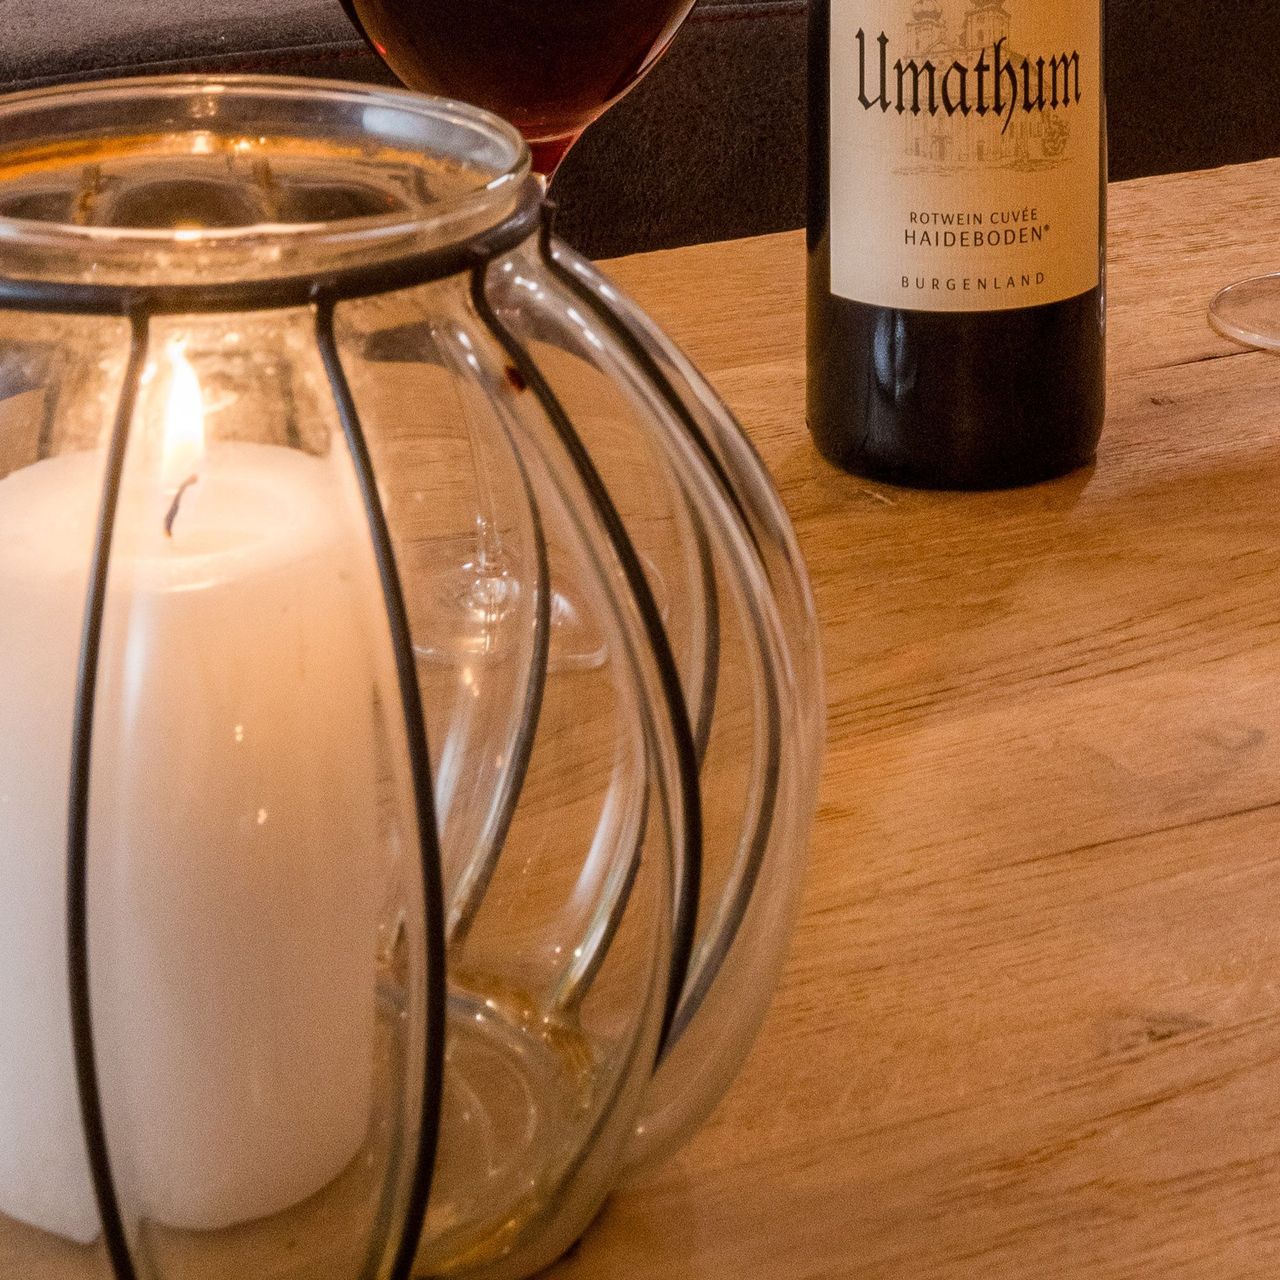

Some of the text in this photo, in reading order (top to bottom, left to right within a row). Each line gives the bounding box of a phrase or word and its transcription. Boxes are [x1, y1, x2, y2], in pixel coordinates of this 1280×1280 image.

[856, 27, 1082, 135] Umathum
[910, 207, 1038, 225] ROTWEIN CUVÉE
[901, 272, 1044, 290] BURGENLAND
